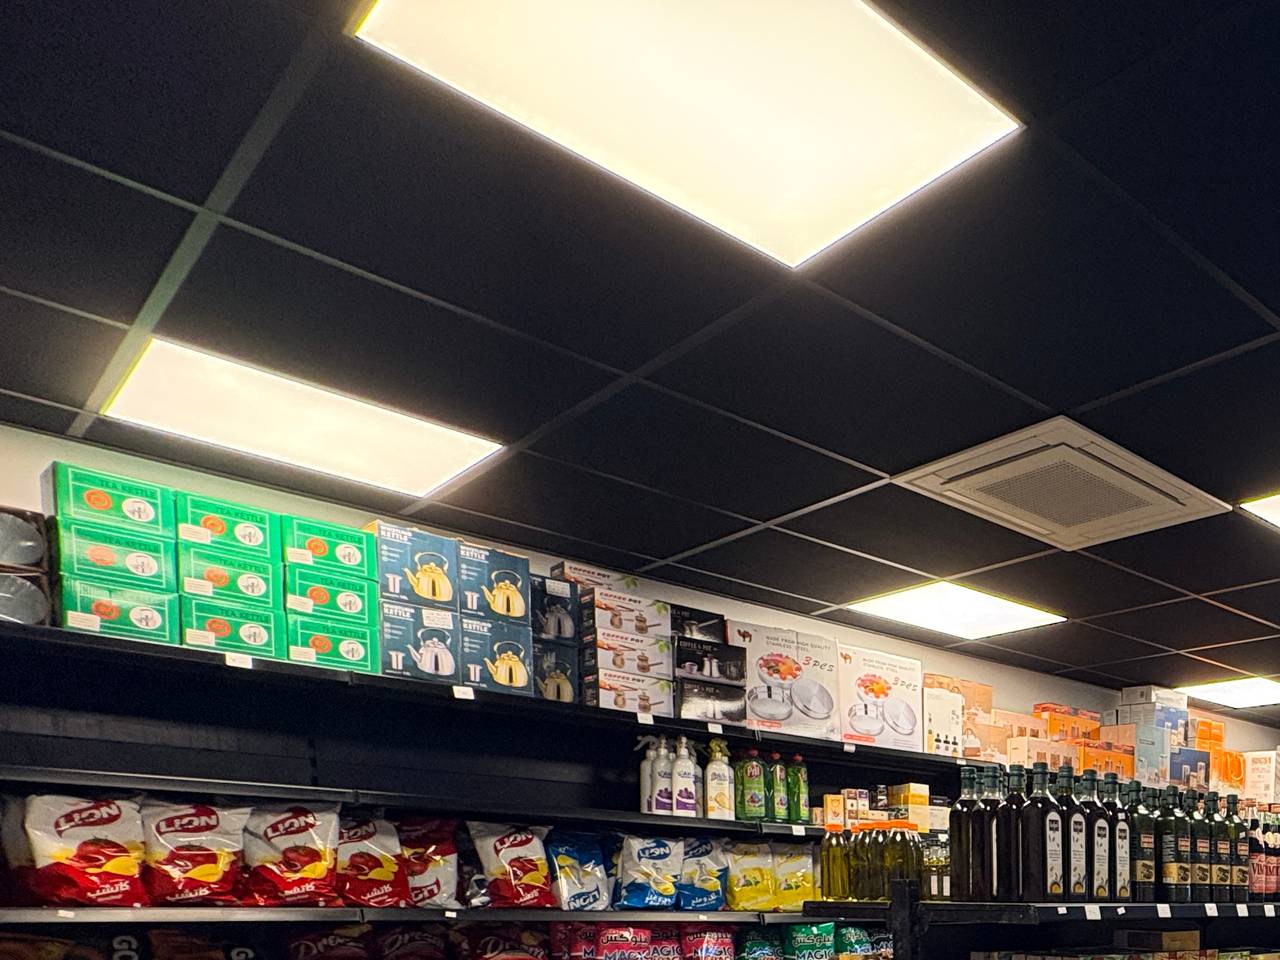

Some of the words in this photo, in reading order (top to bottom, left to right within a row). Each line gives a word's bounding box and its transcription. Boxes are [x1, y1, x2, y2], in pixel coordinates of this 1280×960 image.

[99, 478, 117, 491] TEA
[117, 482, 157, 498] KETTLE
[216, 504, 234, 516] TEA
[235, 507, 266, 524] KETTLE
[380, 530, 409, 542] KETTLE
[460, 550, 487, 561] KETTLE
[218, 556, 237, 567] TEA
[238, 558, 268, 574] KETTLE
[569, 566, 596, 577] COFFEE
[600, 591, 627, 603] COFFEE
[220, 607, 239, 618] TEA
[239, 609, 271, 624] KETTLE
[383, 607, 412, 619] KETTLE
[462, 623, 489, 633] KETTLE
[602, 631, 629, 642] COFFEE
[604, 672, 631, 682] COFFEE
[55, 803, 121, 832] LION
[159, 812, 219, 834] LION
[264, 812, 320, 841] LION
[495, 830, 535, 850] LION
[641, 843, 671, 859] LION
